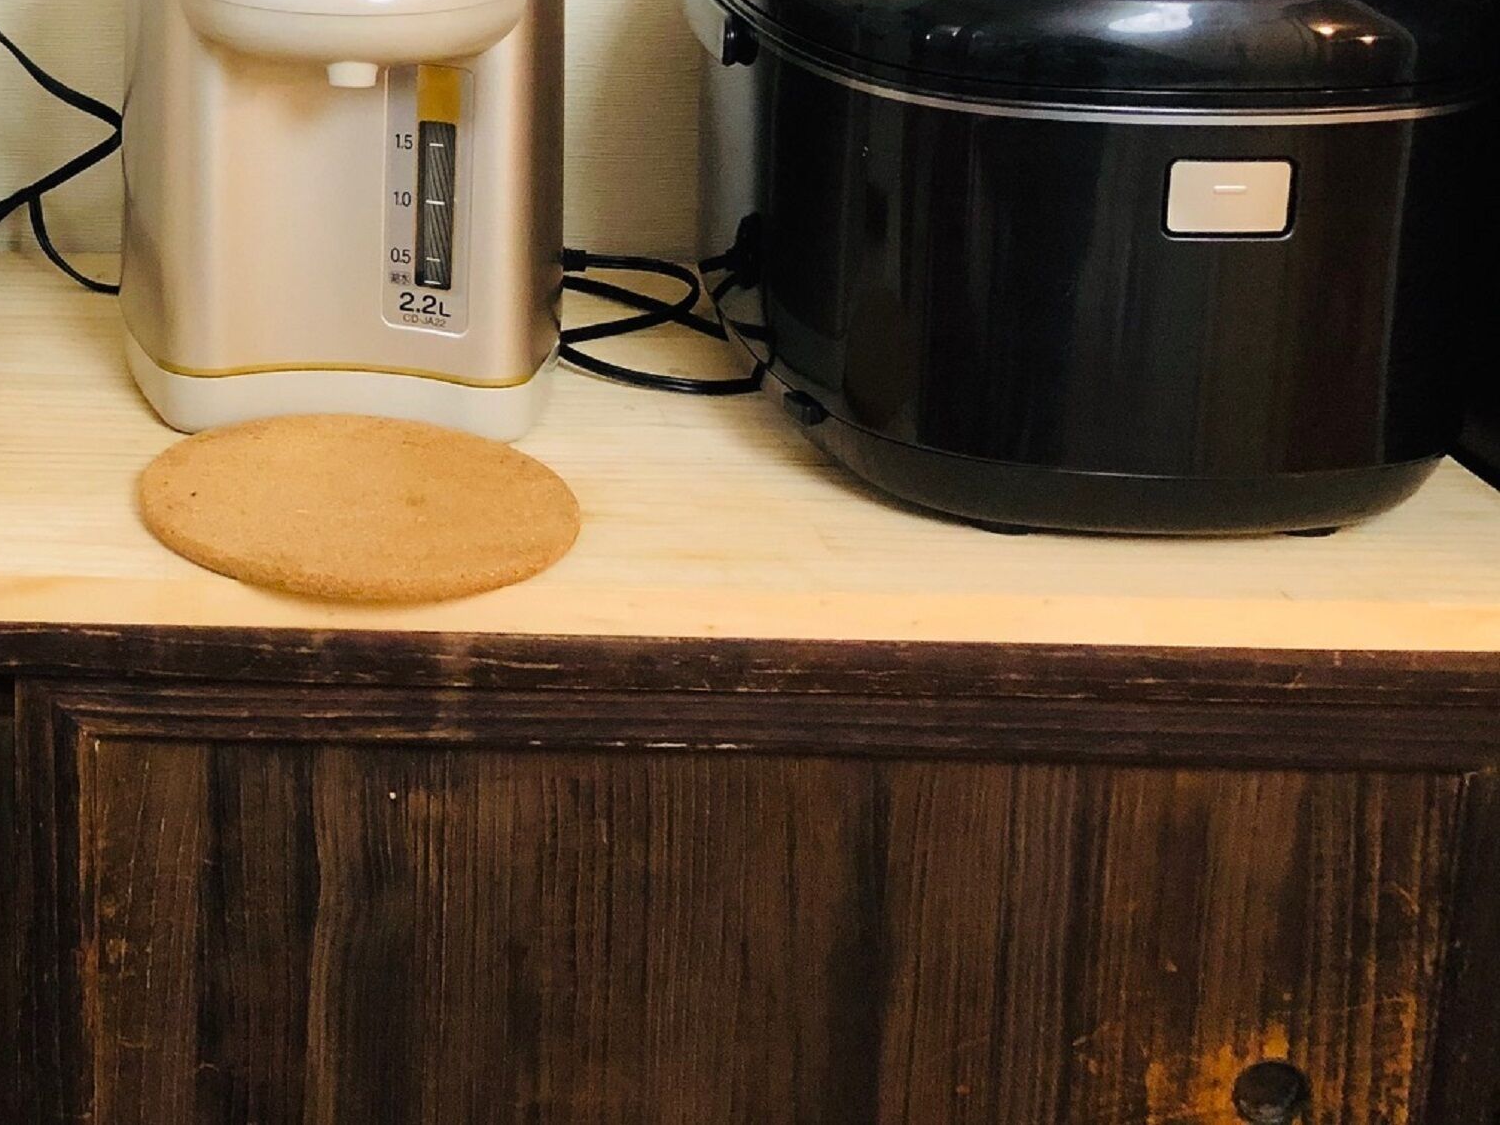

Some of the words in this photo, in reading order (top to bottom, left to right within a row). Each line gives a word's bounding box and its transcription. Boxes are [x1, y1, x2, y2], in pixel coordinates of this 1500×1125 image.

[395, 134, 413, 149] 1.5
[393, 191, 411, 207] 1.0
[390, 247, 411, 264] 0.5
[399, 292, 451, 318] 2.2L
